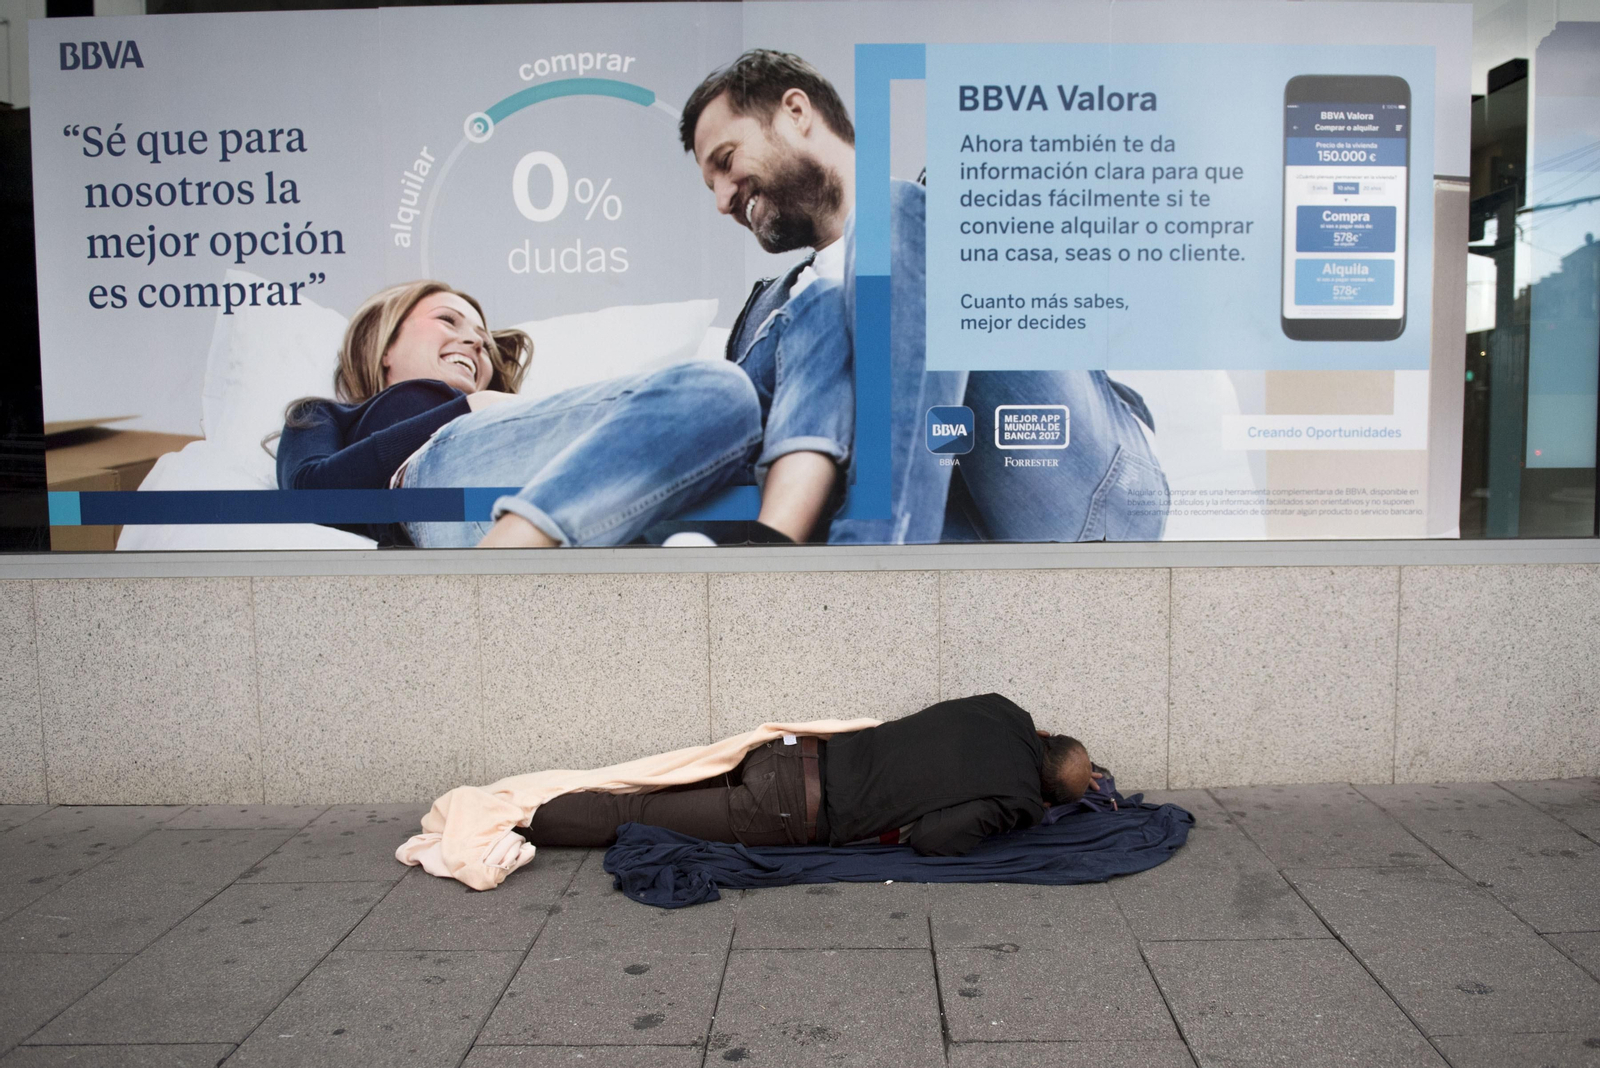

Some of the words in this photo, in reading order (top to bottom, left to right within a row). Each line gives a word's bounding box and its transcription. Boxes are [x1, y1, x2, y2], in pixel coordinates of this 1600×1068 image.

[59, 40, 144, 70] BBVA
[518, 52, 636, 81] comprar
[959, 85, 1048, 112] BBVA
[1057, 84, 1158, 112] Valora
[1320, 111, 1345, 120] BBVA
[1346, 111, 1374, 120] Valora
[1314, 123, 1346, 132] Comprar
[1352, 124, 1380, 132] alquilar
[63, 123, 126, 157] “Sé
[136, 129, 208, 164] que
[218, 126, 307, 162] para
[960, 134, 1024, 153] Ahora
[1030, 133, 1117, 153] también
[1123, 136, 1144, 153] te
[1150, 134, 1176, 153] da
[1315, 141, 1336, 149] Precio
[1317, 150, 1367, 162] 150.000
[1369, 153, 1377, 162] €
[960, 161, 1088, 180] información
[1094, 162, 1145, 180] clara
[1152, 164, 1198, 184] para
[1205, 165, 1244, 184] que
[85, 177, 255, 208] nosotros
[265, 171, 300, 205] la
[390, 145, 435, 248] alquilar
[959, 189, 1042, 207] decidas
[1048, 189, 1160, 207] fácilmente
[1166, 190, 1183, 207] si
[1190, 191, 1211, 207] te
[1322, 210, 1370, 224] Compra
[959, 217, 1055, 235] conviene
[1060, 216, 1140, 239] alquilar
[1145, 221, 1159, 235] o
[1164, 220, 1254, 239] comprar
[86, 225, 199, 265] mejor
[209, 222, 346, 264] opción
[508, 238, 629, 274] dudas
[960, 247, 998, 262] una
[1005, 247, 1059, 264] casa,
[1065, 247, 1112, 262] seas
[1118, 247, 1131, 262] o
[1137, 247, 1163, 262] no
[1169, 244, 1246, 262] cliente.
[1322, 263, 1369, 277] Alquila
[88, 283, 128, 309] es
[138, 272, 326, 315] comprar”
[960, 293, 1026, 310] Cuanto
[1031, 293, 1068, 309] más
[1073, 293, 1129, 311] sabes,
[960, 315, 1012, 333] mejor
[1017, 314, 1086, 330] decides
[1004, 415, 1037, 423] MEJOR
[1040, 415, 1060, 423] APP
[1004, 423, 1046, 431] MUNDIAL
[1047, 423, 1060, 431] DE
[932, 424, 968, 436] BBVA
[1004, 432, 1036, 440] BANCA
[1038, 432, 1060, 440] 2017
[1248, 426, 1302, 438] Creando
[1306, 426, 1402, 440] Oportunidades
[939, 458, 960, 466] BBVA
[1127, 488, 1156, 497] Alquilar
[1225, 488, 1270, 496] herramienta
[1271, 488, 1333, 497] complementaria
[1334, 488, 1344, 496] de
[1370, 488, 1408, 497] disponible
[1220, 498, 1265, 506] información
[1266, 498, 1303, 506] facilitados
[1320, 498, 1364, 506] orientativos
[1382, 499, 1415, 507] suponen
[1190, 508, 1248, 516] recomendación
[1318, 508, 1353, 517] producto
